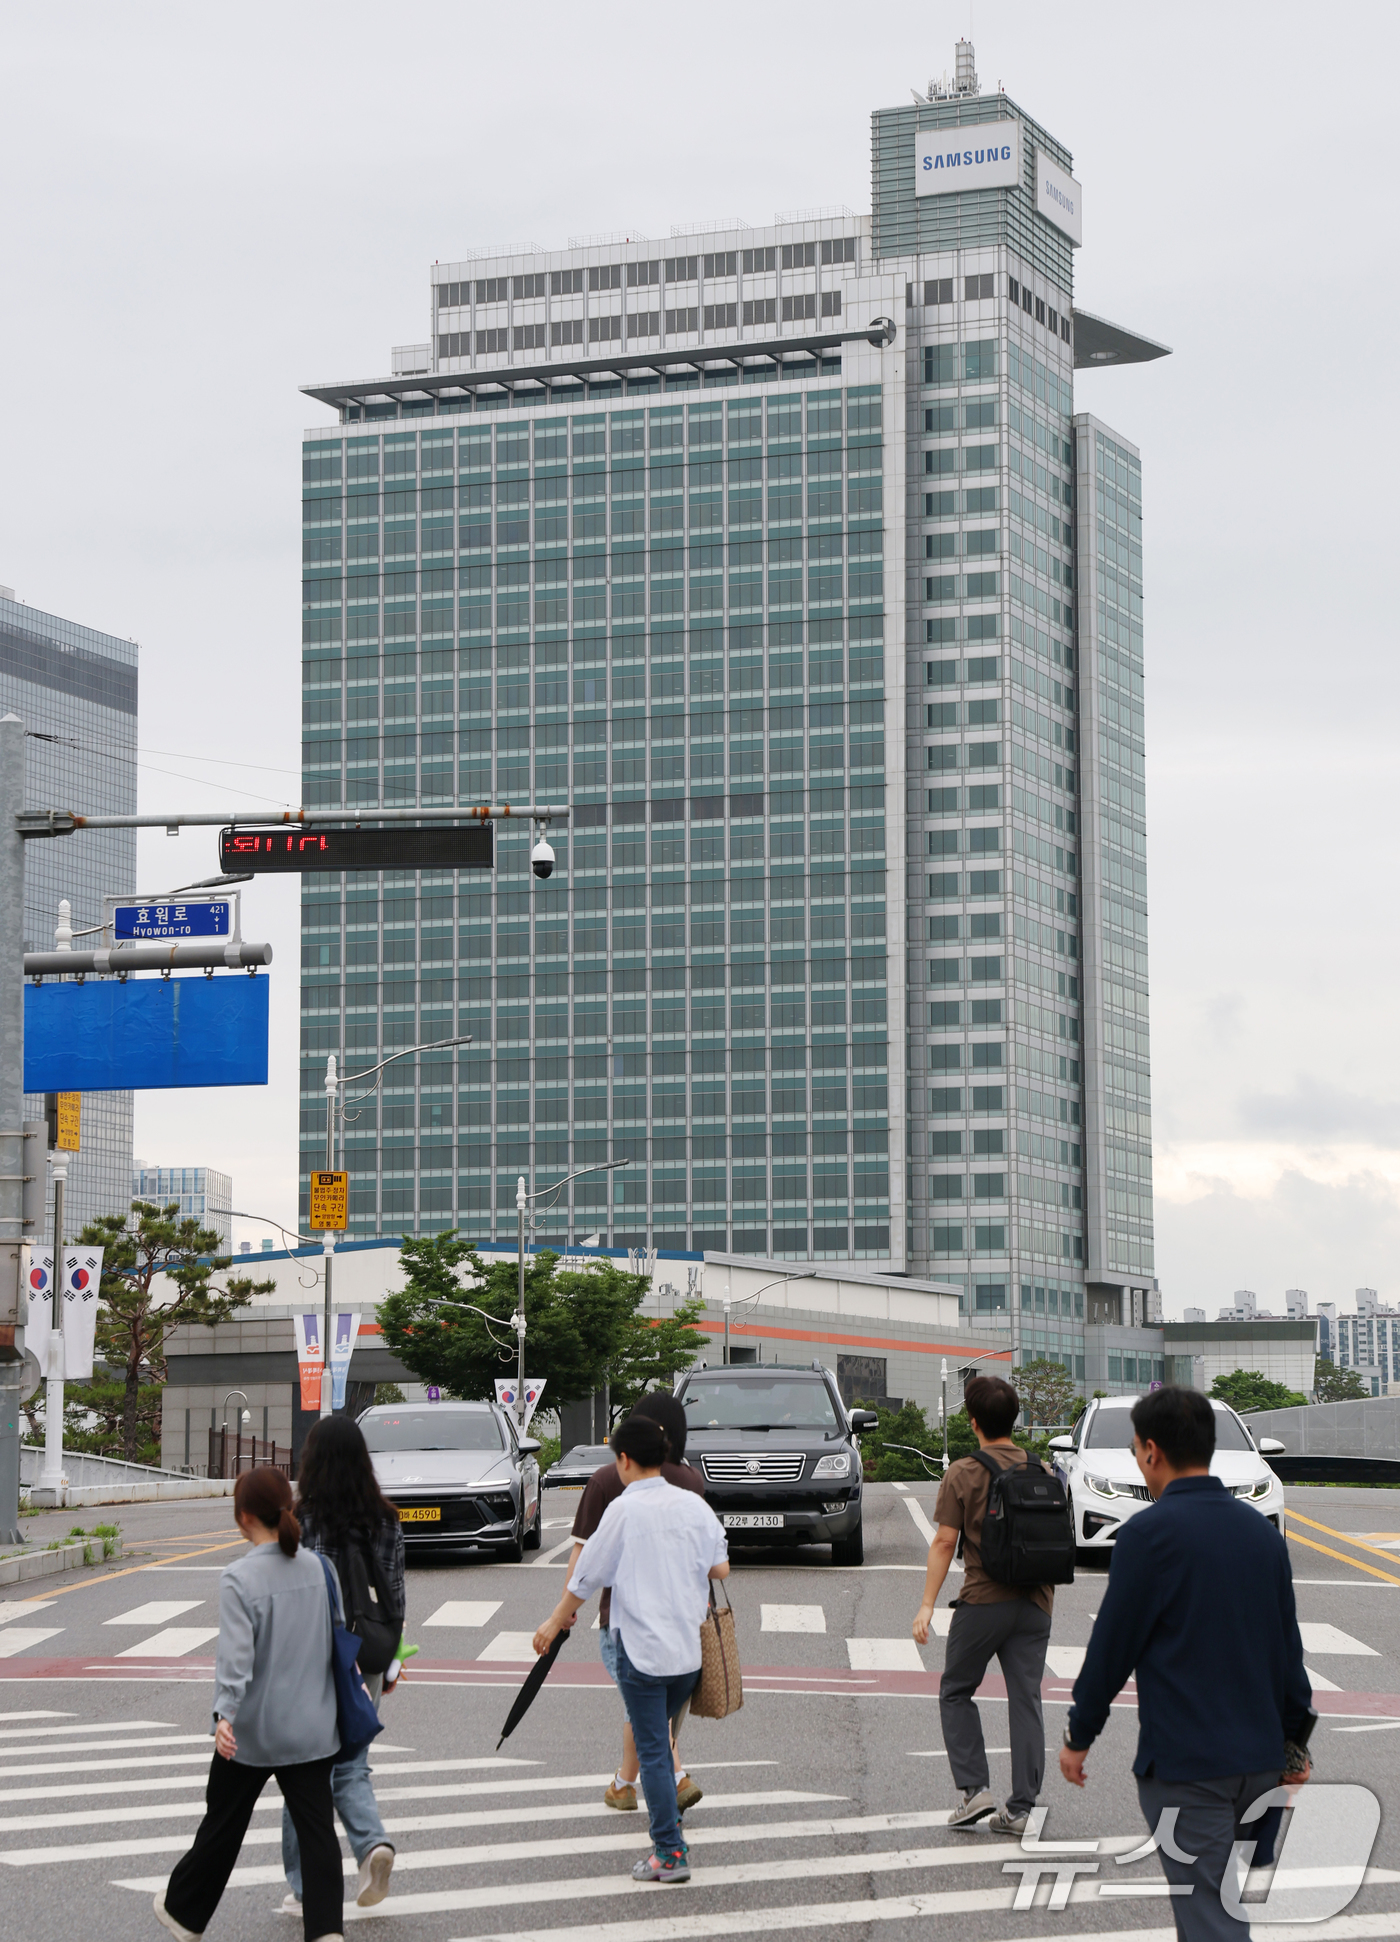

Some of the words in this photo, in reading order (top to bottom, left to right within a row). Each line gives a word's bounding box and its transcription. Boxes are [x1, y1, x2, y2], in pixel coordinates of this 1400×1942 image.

[923, 146, 1011, 171] SAMSUNG
[1045, 180, 1074, 215] SAMSUNG
[209, 905, 224, 914] 421
[136, 906, 188, 925] 효원로
[133, 925, 191, 937] Hyowon-ro
[214, 924, 219, 932] 1
[314, 1203, 327, 1212] 단속
[330, 1203, 344, 1212] 구간
[412, 1509, 437, 1519] 4590
[753, 1516, 779, 1526] 2130
